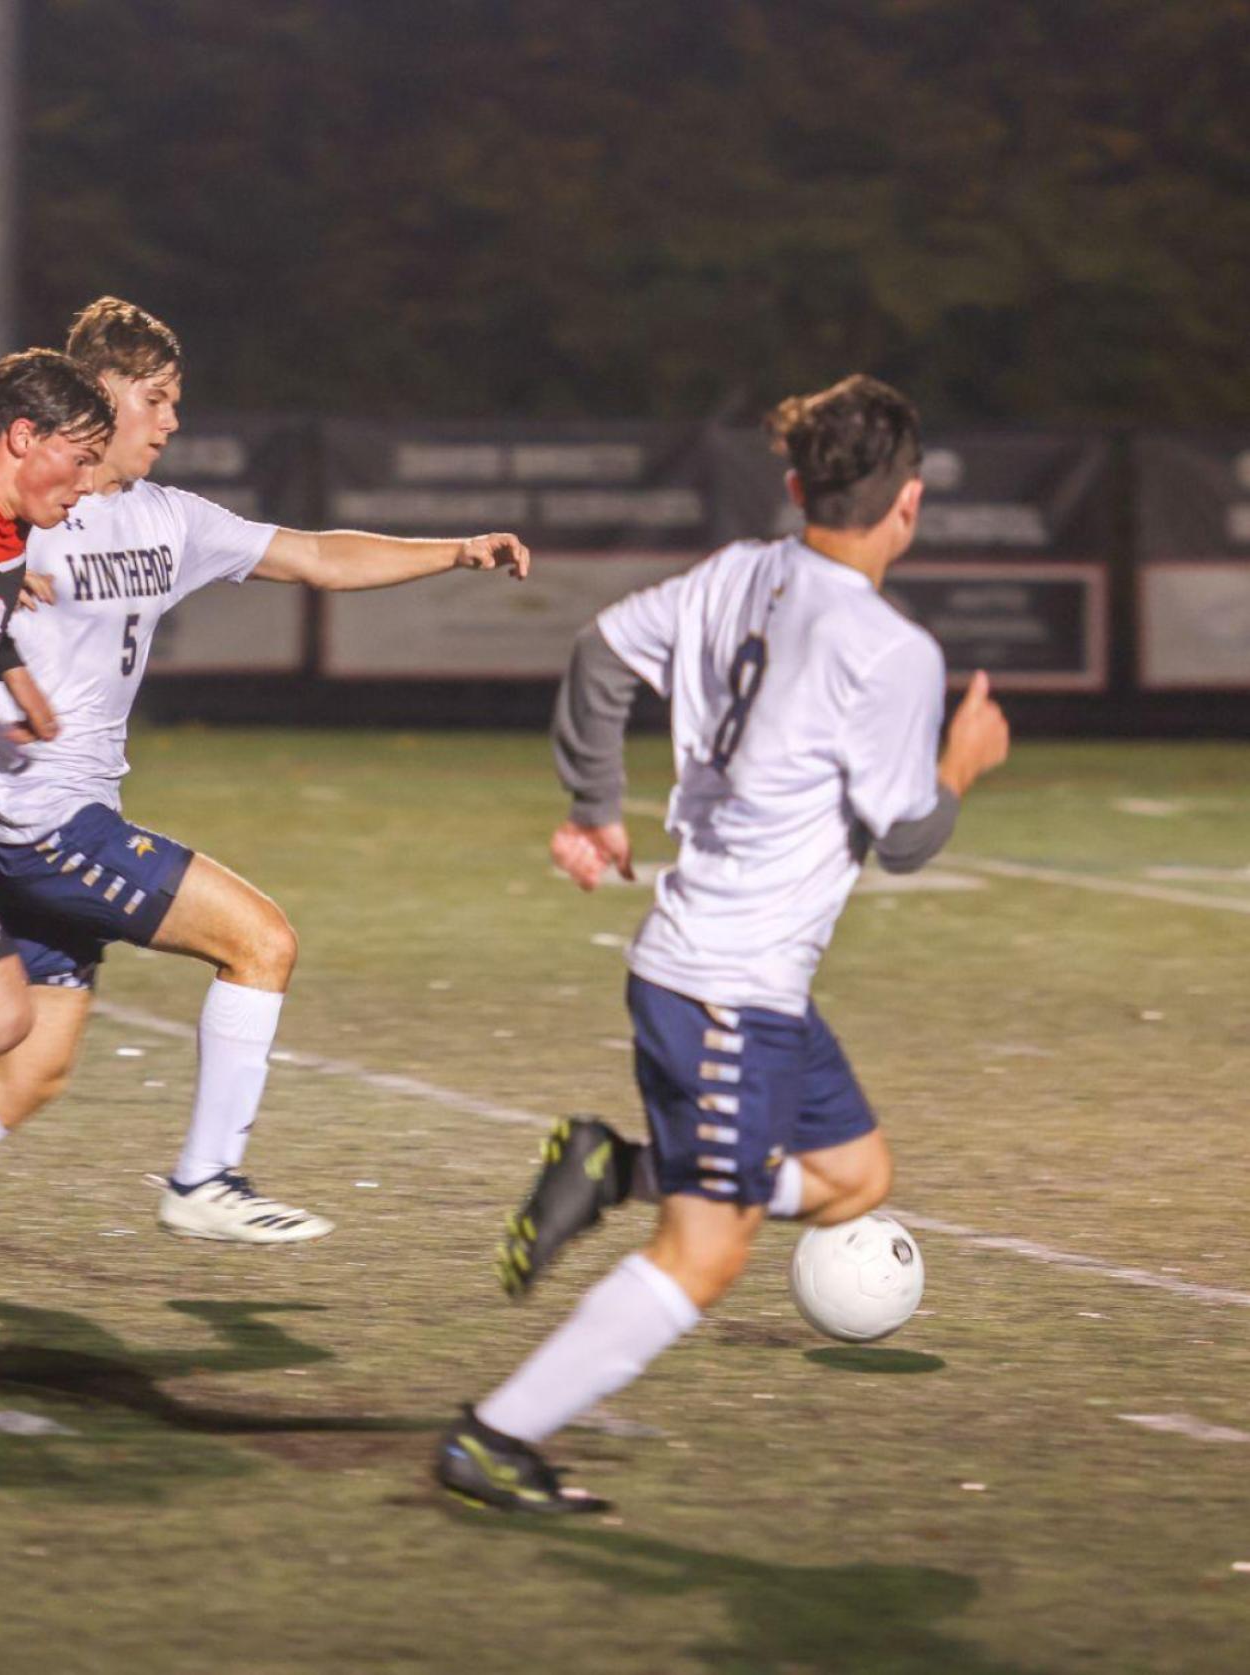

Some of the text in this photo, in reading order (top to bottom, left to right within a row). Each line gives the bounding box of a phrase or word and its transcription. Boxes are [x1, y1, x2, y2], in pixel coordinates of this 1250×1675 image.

[66, 545, 173, 600] WINTHROP
[120, 613, 140, 676] 5
[711, 630, 768, 773] 8
